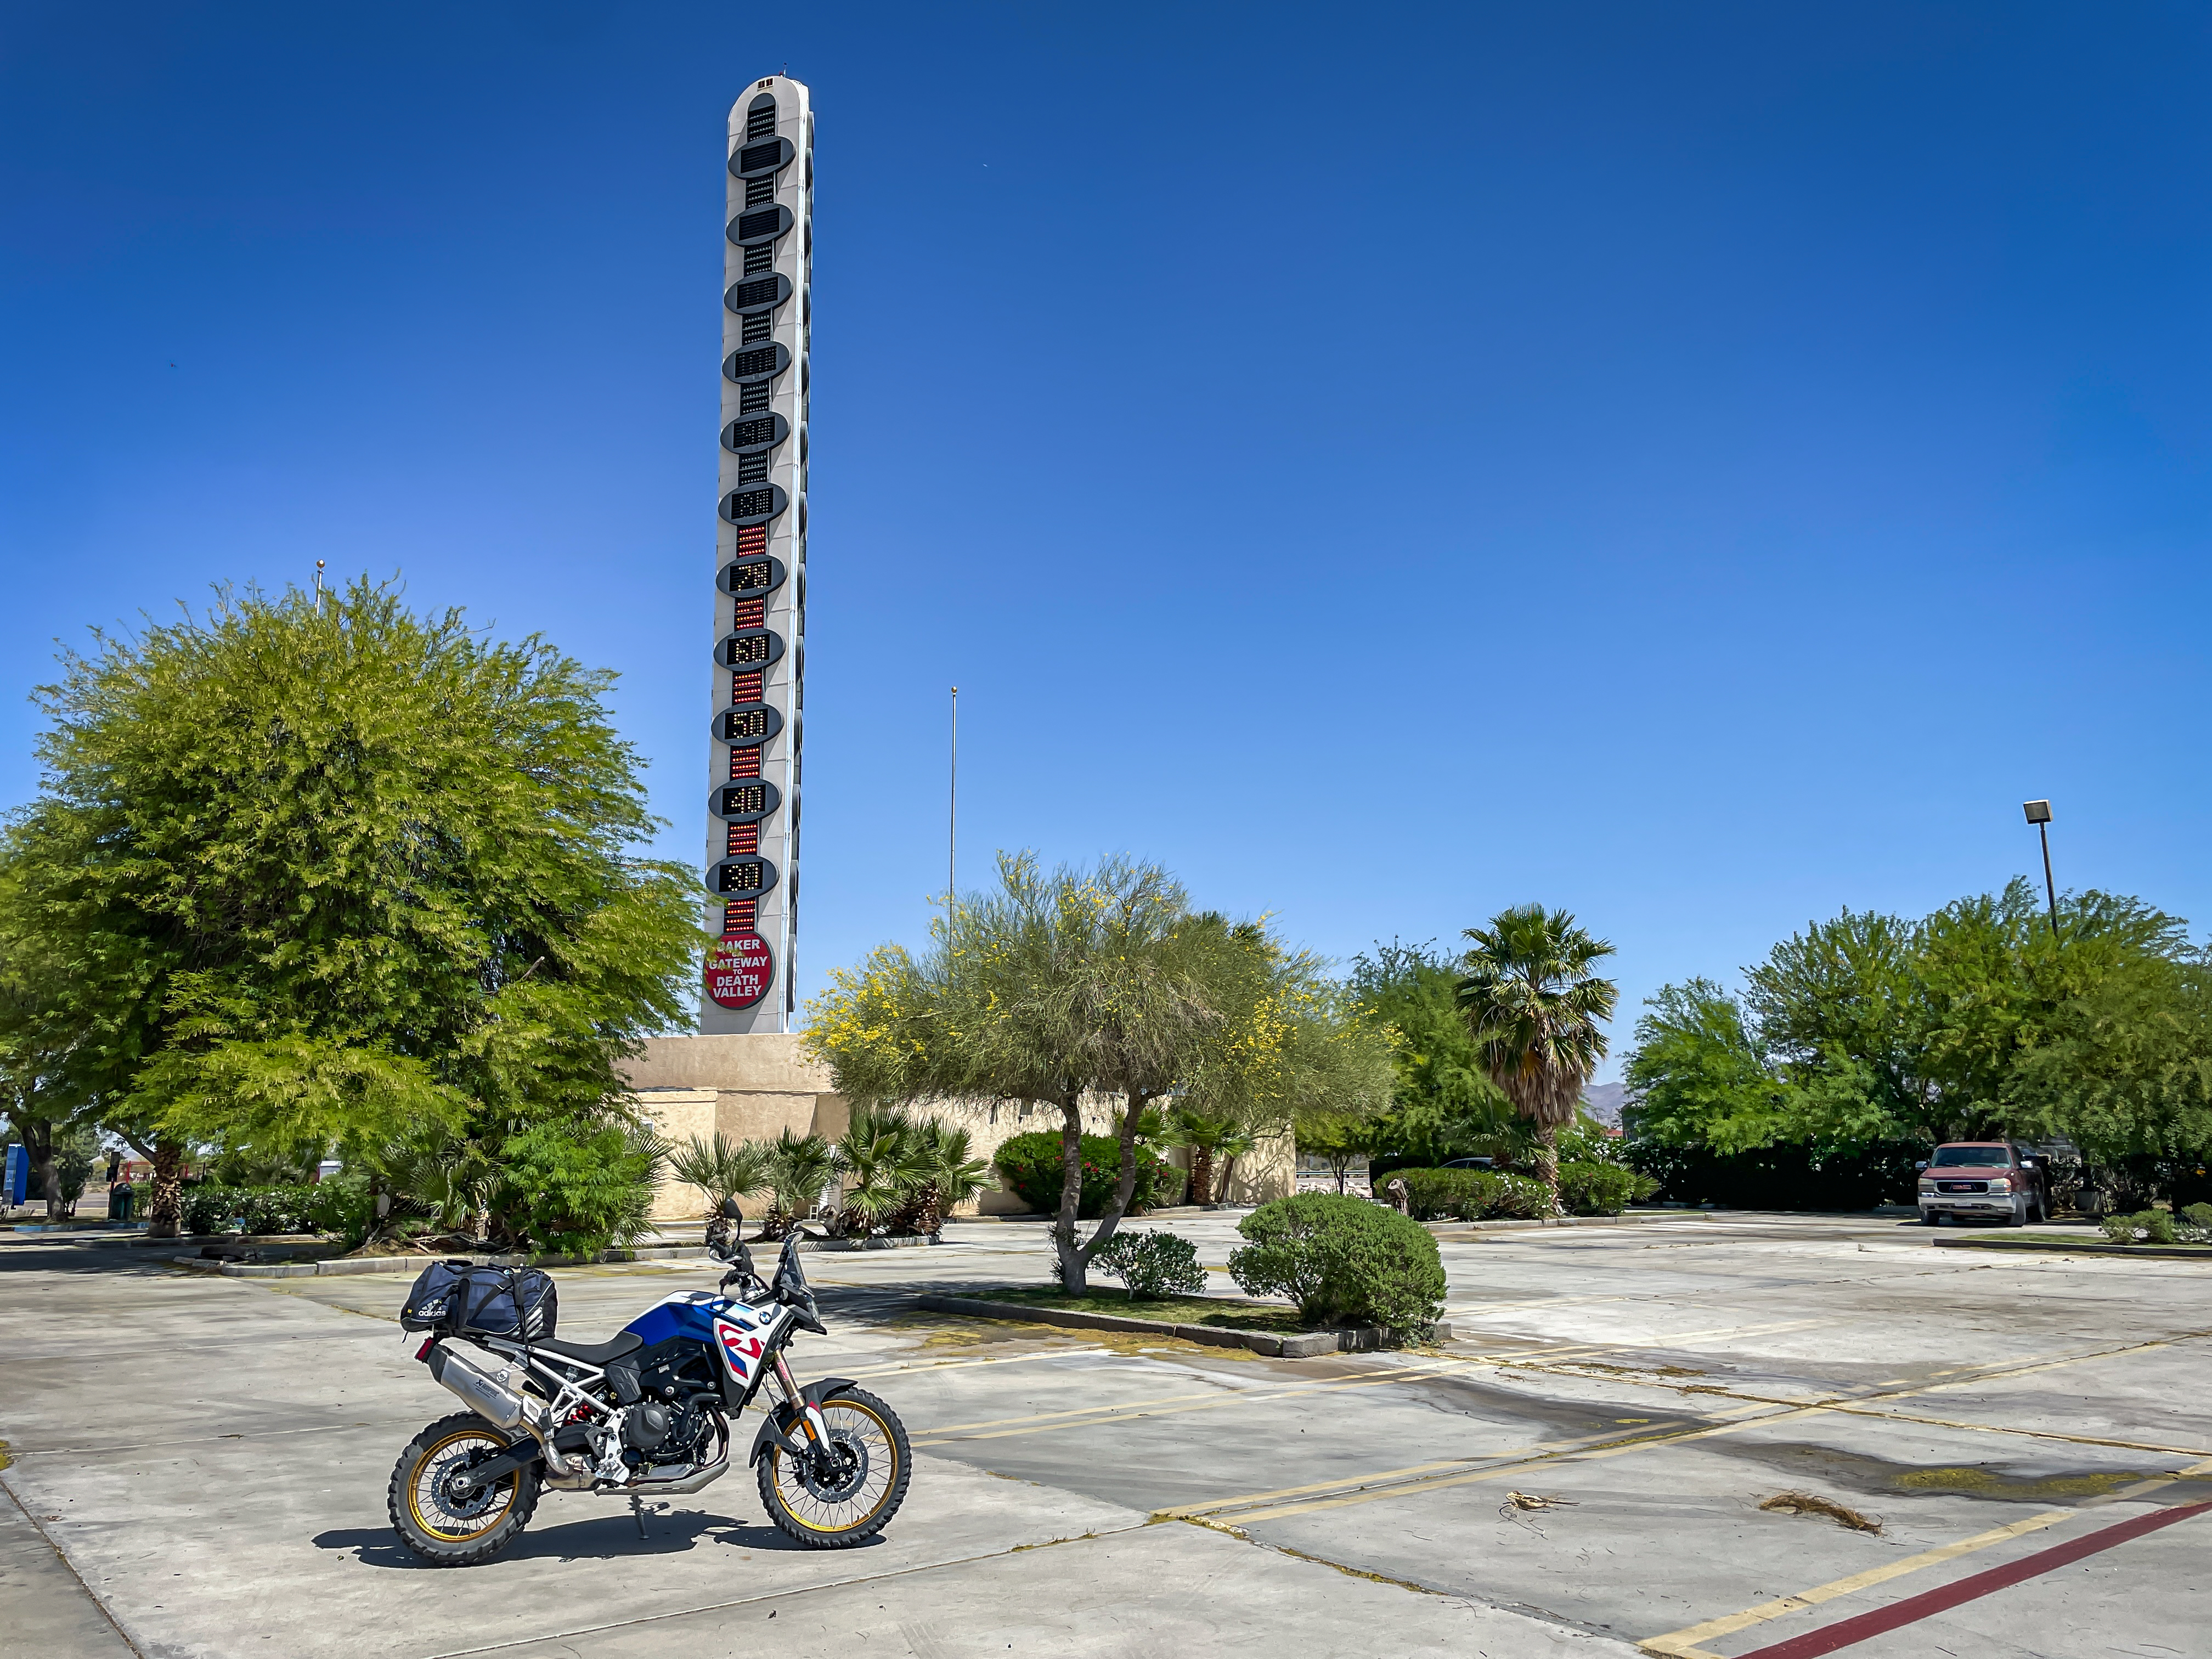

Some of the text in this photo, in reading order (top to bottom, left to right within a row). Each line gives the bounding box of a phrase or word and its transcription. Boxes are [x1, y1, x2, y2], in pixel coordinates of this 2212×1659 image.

[736, 636, 765, 664] 60
[733, 711, 763, 738] 50
[731, 787, 761, 814] 40
[728, 864, 758, 891] 30
[717, 939, 760, 952] BAKER
[709, 956, 768, 969] GATEWAY
[716, 974, 758, 987] DEATH
[713, 985, 761, 998] VALLEY
